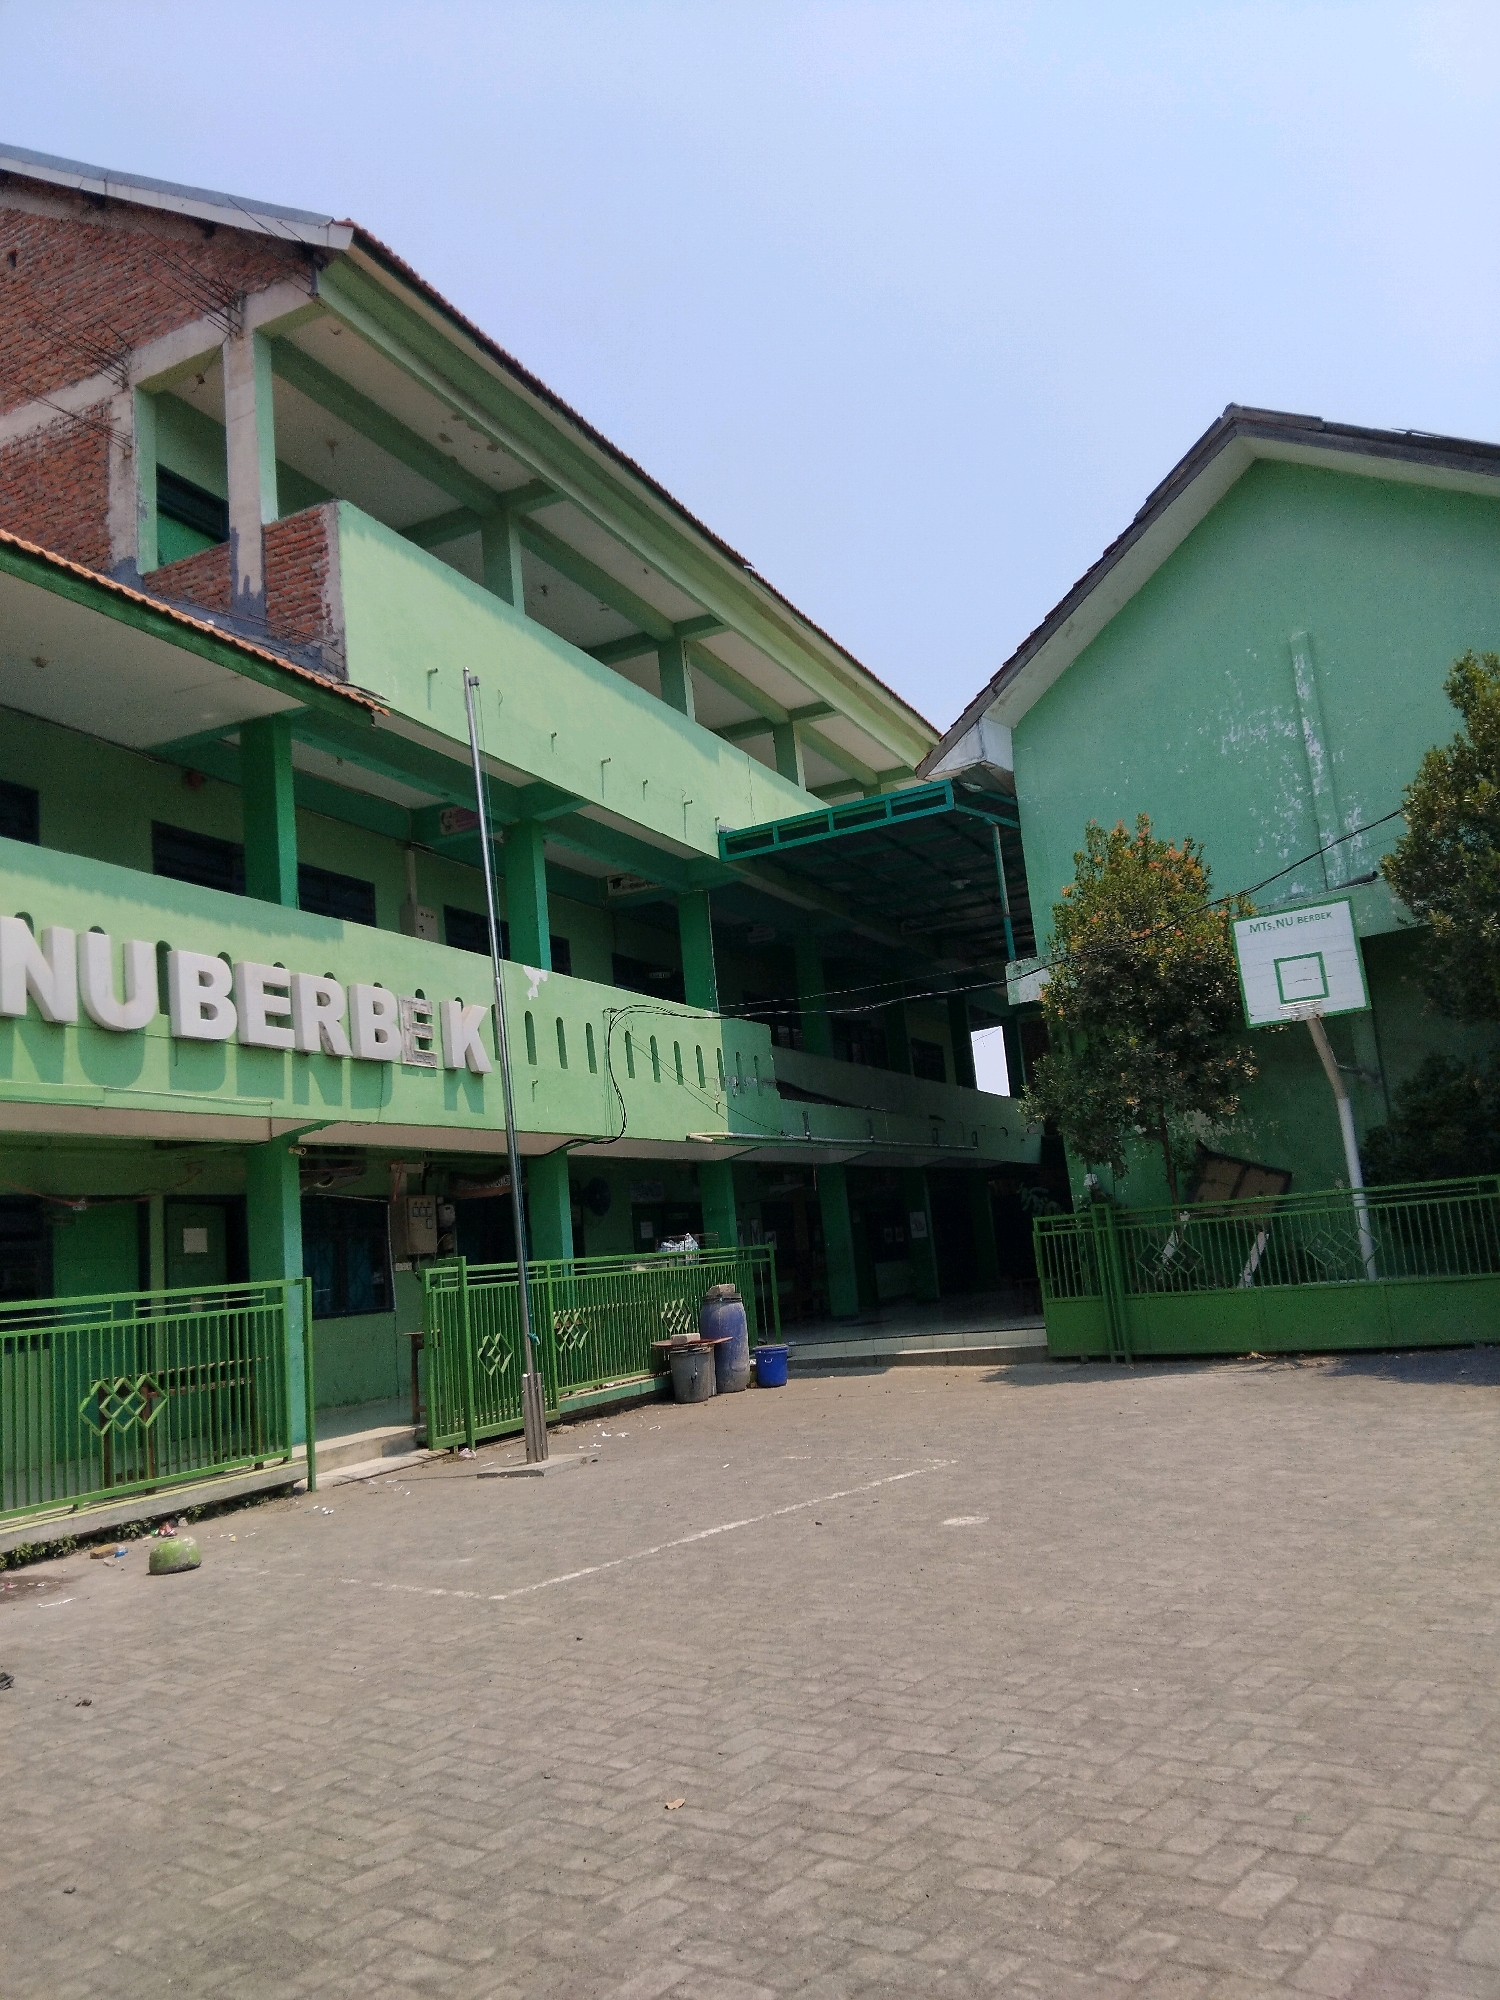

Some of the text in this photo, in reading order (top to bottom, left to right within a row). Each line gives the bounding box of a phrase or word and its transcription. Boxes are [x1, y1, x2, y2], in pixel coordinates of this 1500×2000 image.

[1297, 911, 1333, 924] BERBEK
[0, 915, 493, 1075] NU BERBEK
